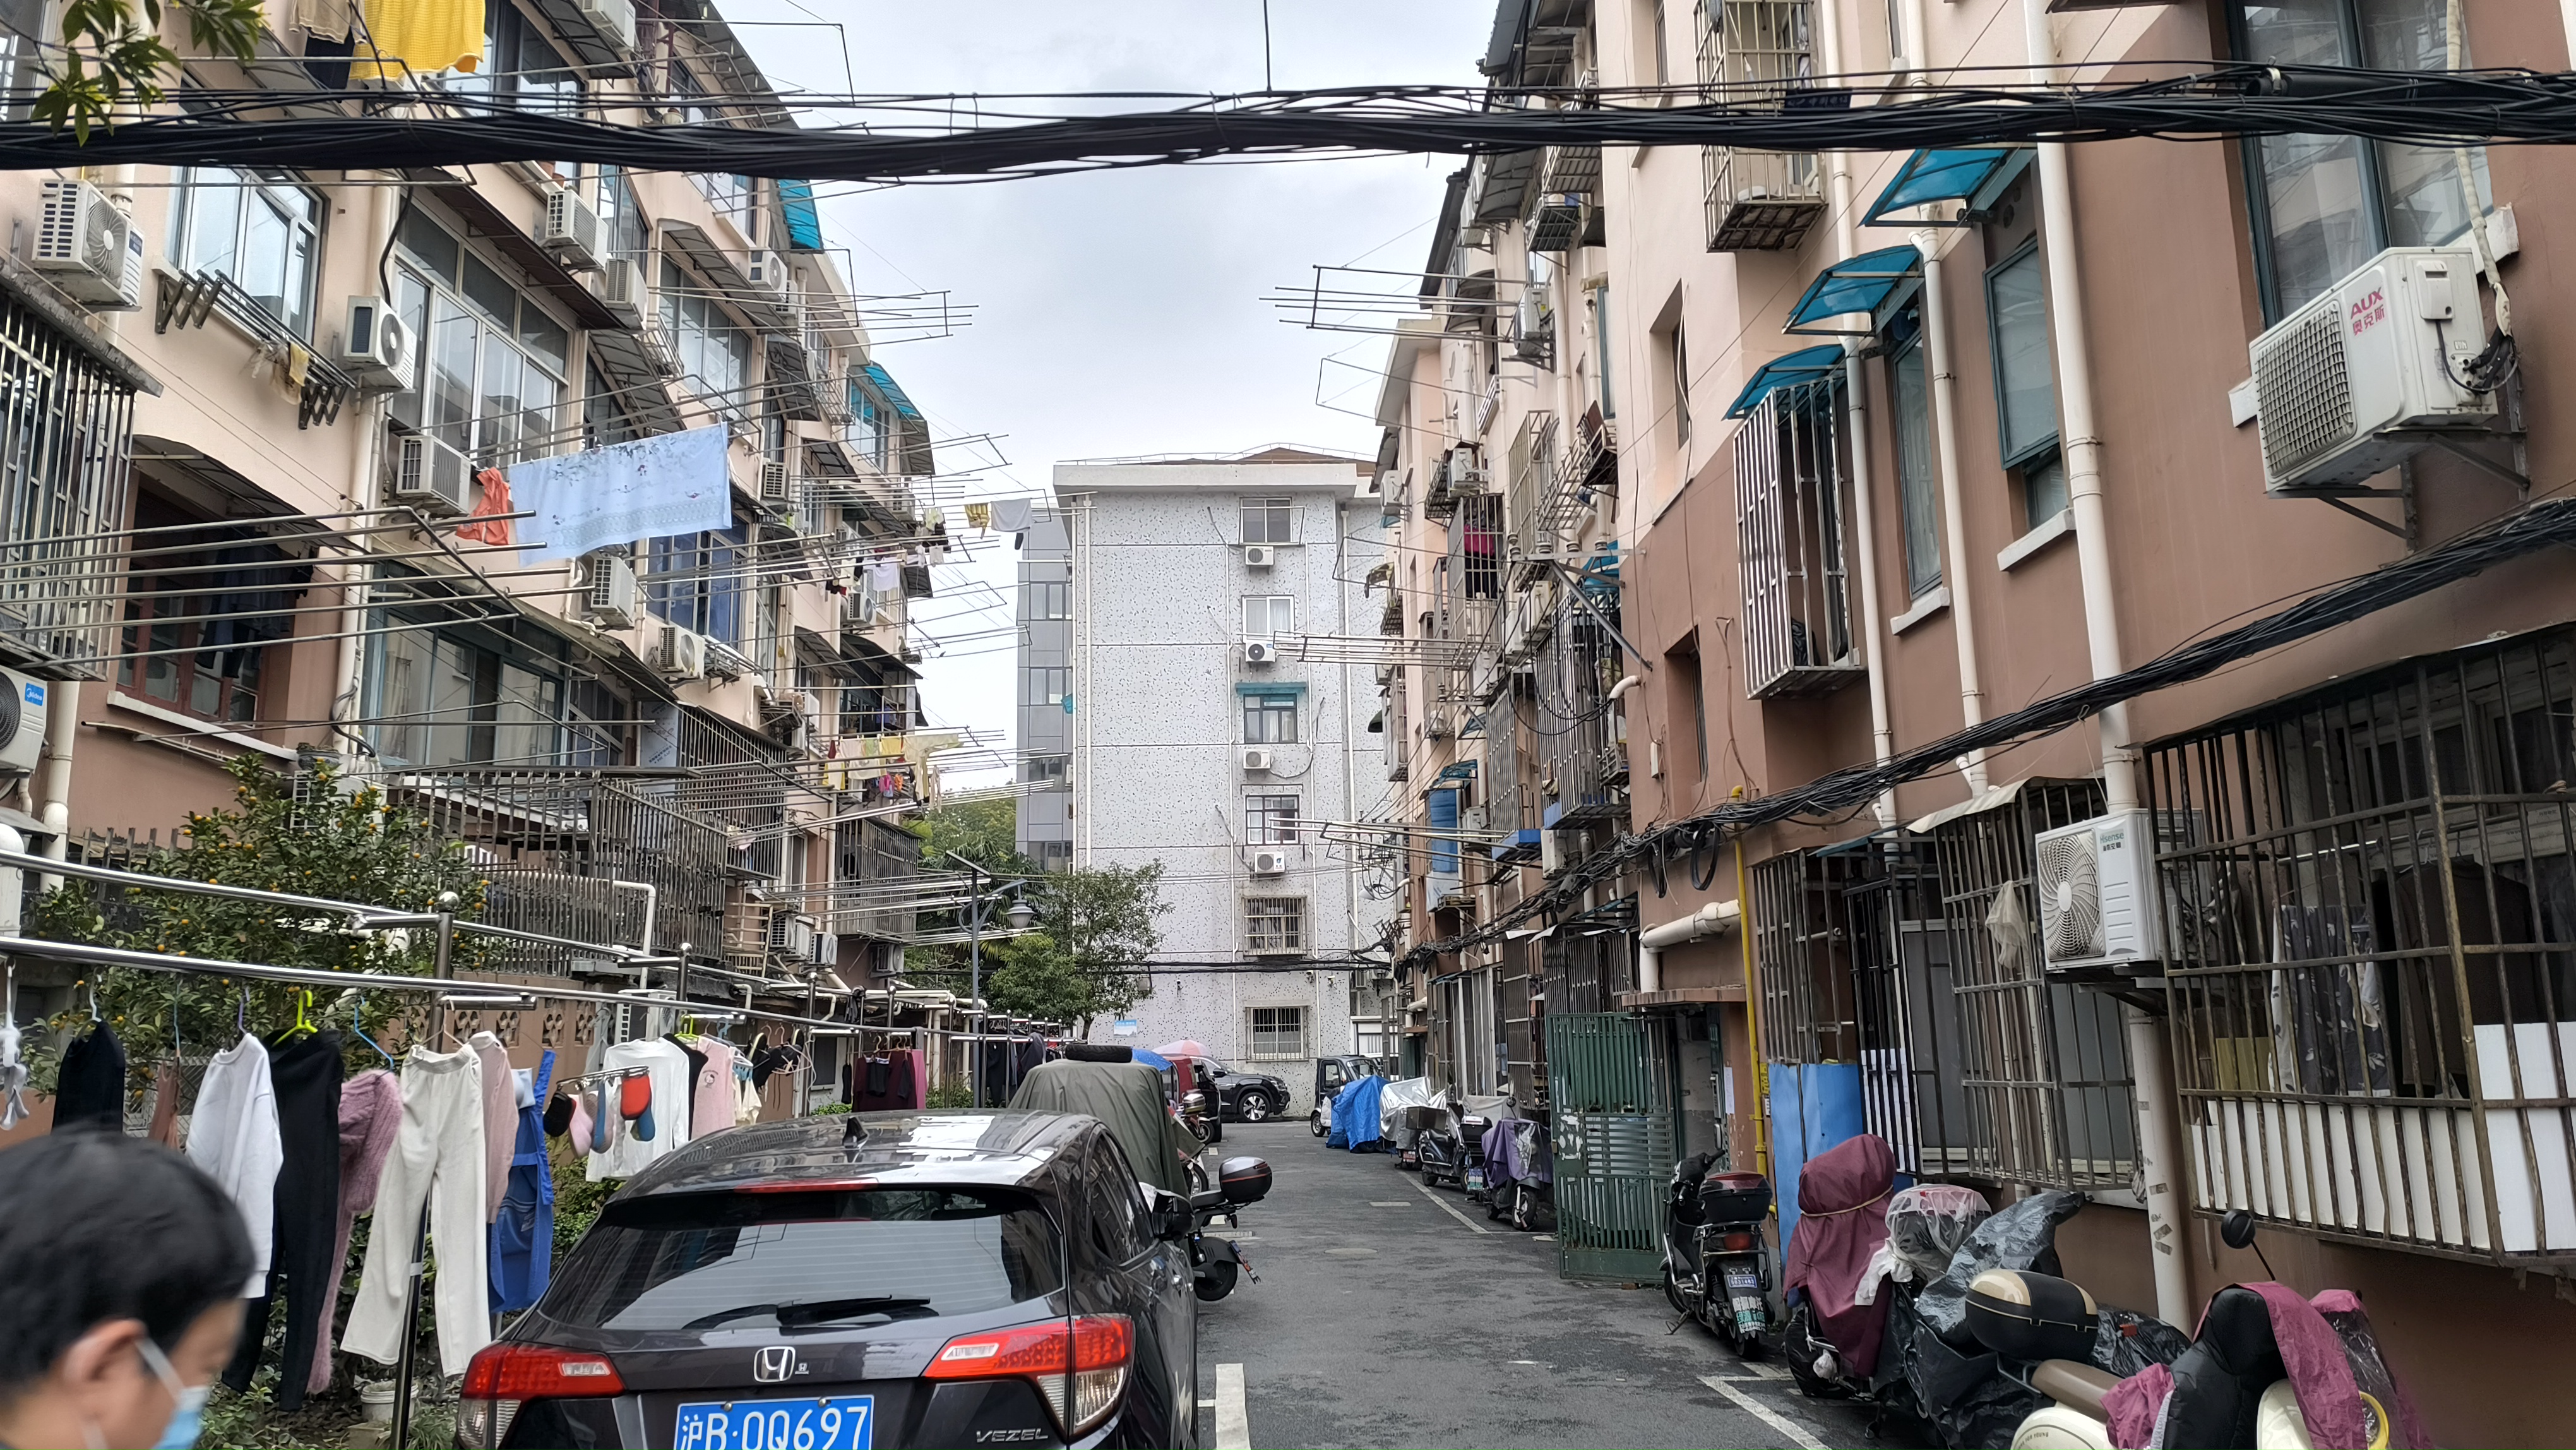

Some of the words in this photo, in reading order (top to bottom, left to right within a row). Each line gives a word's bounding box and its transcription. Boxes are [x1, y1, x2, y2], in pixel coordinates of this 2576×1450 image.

[2350, 286, 2383, 320] AUX
[2352, 304, 2385, 336] 奥克斯
[976, 1428, 1048, 1443] VEZEL
